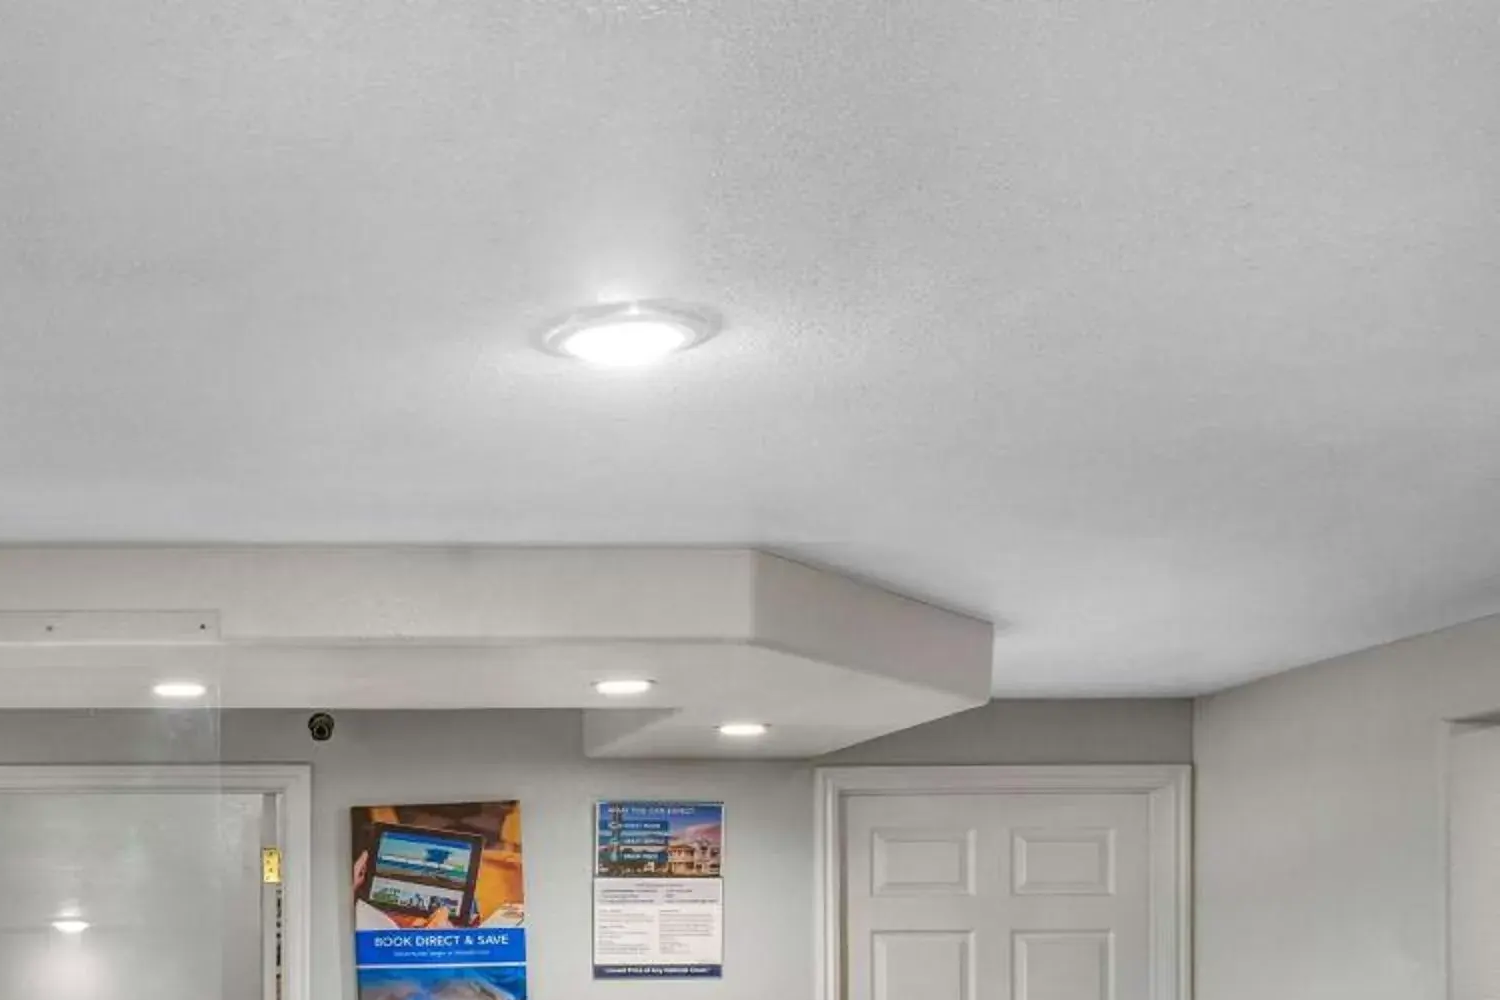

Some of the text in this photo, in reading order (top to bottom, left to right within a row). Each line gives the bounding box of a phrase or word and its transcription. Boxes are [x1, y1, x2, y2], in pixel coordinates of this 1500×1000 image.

[373, 932, 509, 947] BOOK DIRECT & SAVE
